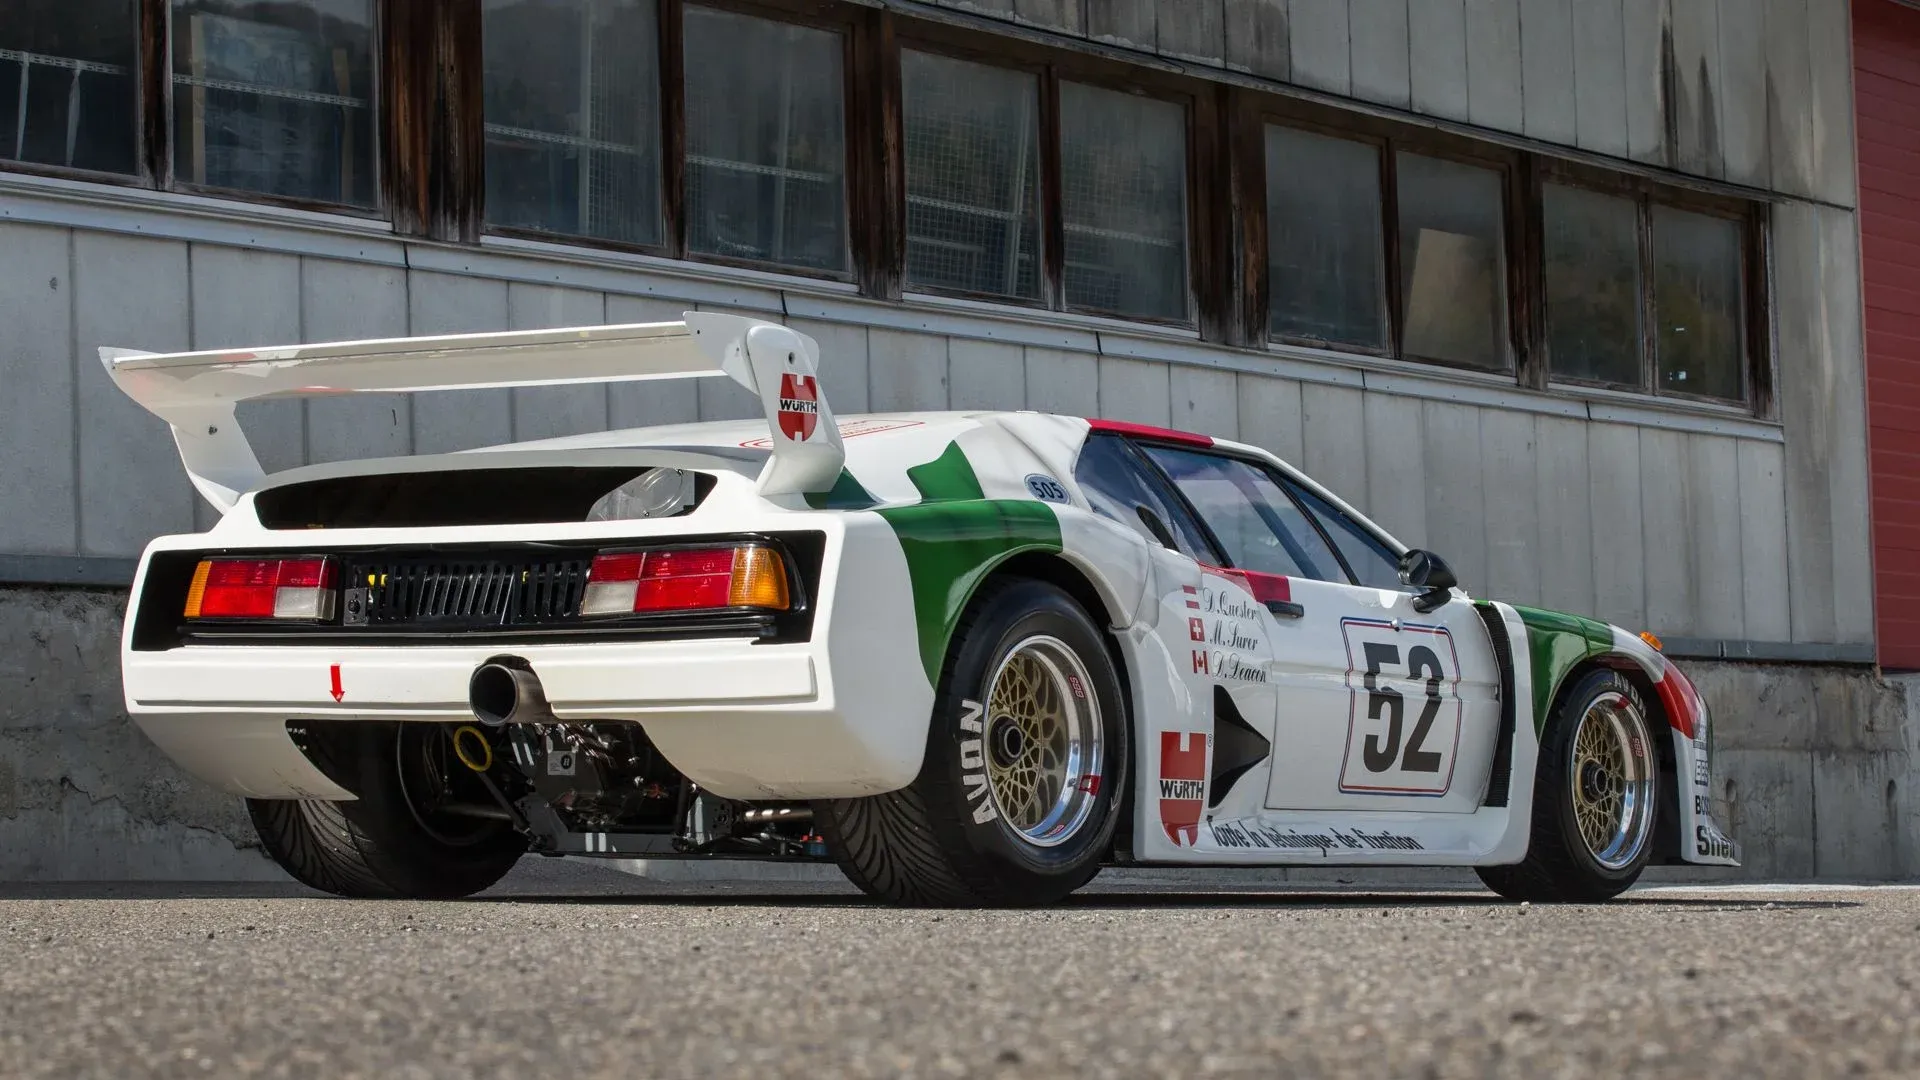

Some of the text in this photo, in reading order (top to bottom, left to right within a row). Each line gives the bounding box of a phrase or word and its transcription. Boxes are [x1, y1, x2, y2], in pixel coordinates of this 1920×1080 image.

[780, 399, 817, 413] WÜRTH
[1030, 481, 1064, 499] 505
[1362, 641, 1444, 773] 52
[959, 699, 999, 825] AVON
[1160, 779, 1204, 800] WÜRTH
[1330, 827, 1362, 849] de
